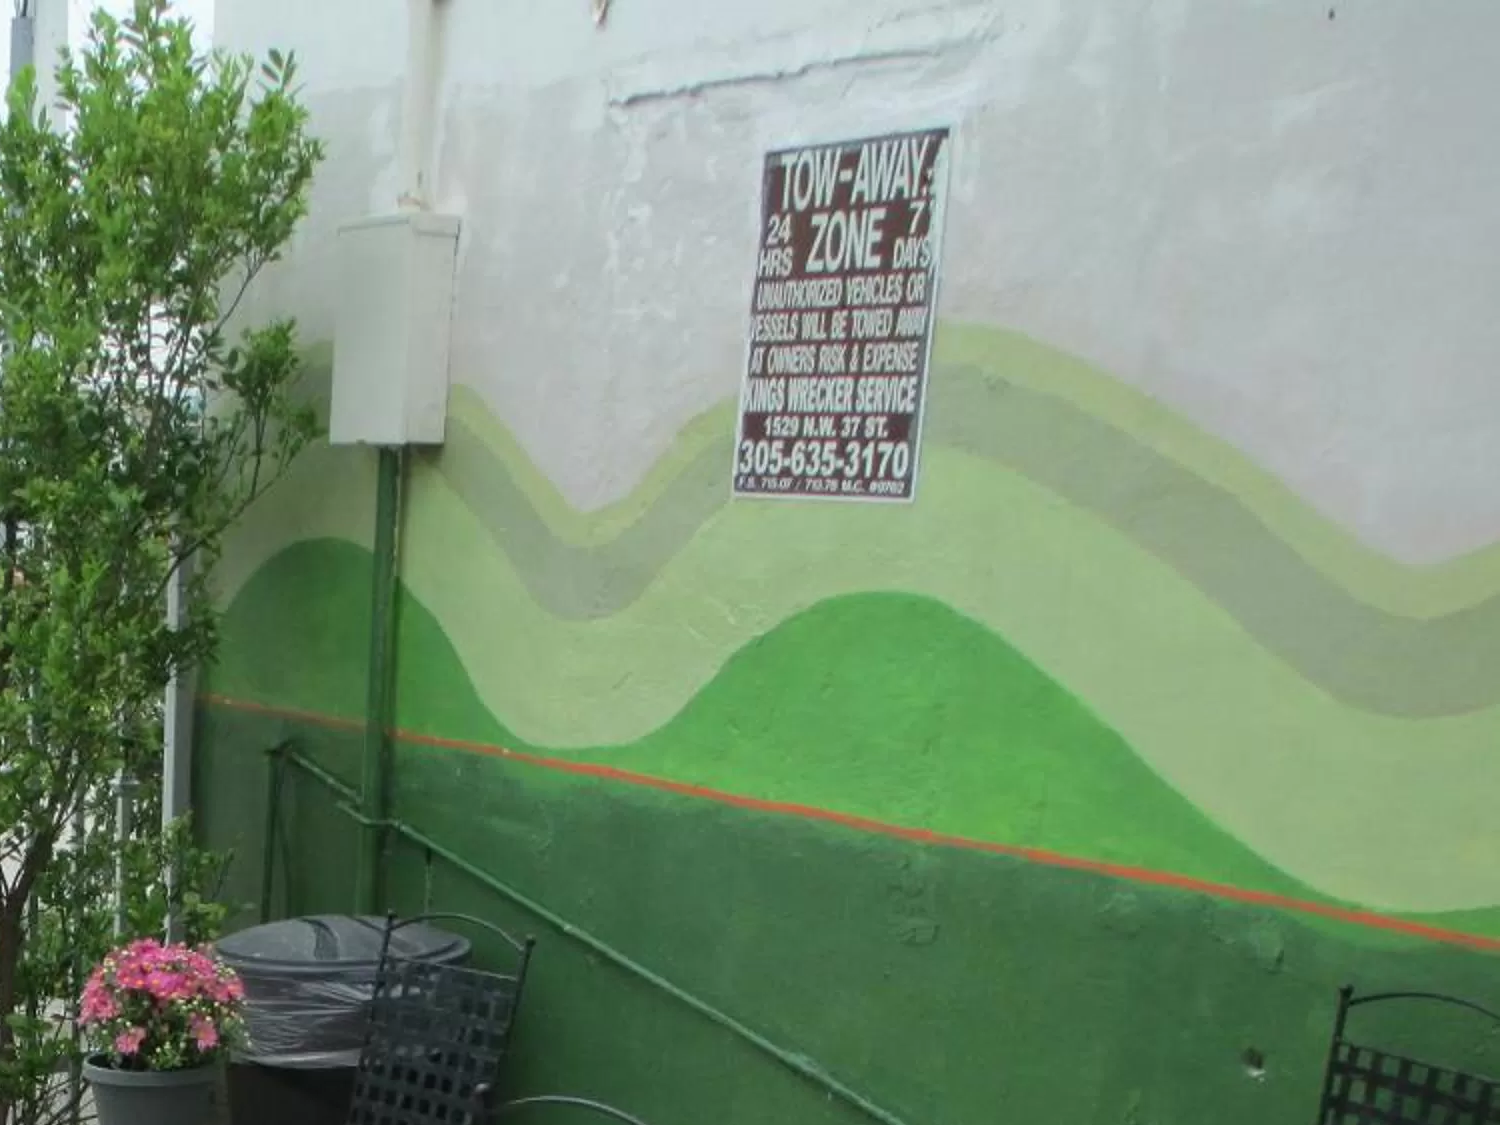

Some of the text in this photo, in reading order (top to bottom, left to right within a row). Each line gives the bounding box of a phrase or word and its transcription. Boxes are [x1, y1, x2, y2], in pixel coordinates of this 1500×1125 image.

[765, 214, 793, 245] 24
[909, 201, 926, 235] 7
[805, 208, 887, 273] ZONE
[892, 236, 931, 270] DAYS
[758, 246, 793, 277] HRS
[757, 272, 926, 310] UNAUTHORIZED VEHICLES OR
[801, 310, 827, 339] WILL
[831, 310, 849, 338] BE
[852, 308, 893, 337] TOWED
[750, 341, 919, 374] AT OWNERS RISK & EXPENSE
[745, 375, 918, 413] KINGS WRECKER SERVICE
[764, 415, 888, 438] 1529 N.W. 37 ST.
[740, 439, 909, 479] 305-635-3170
